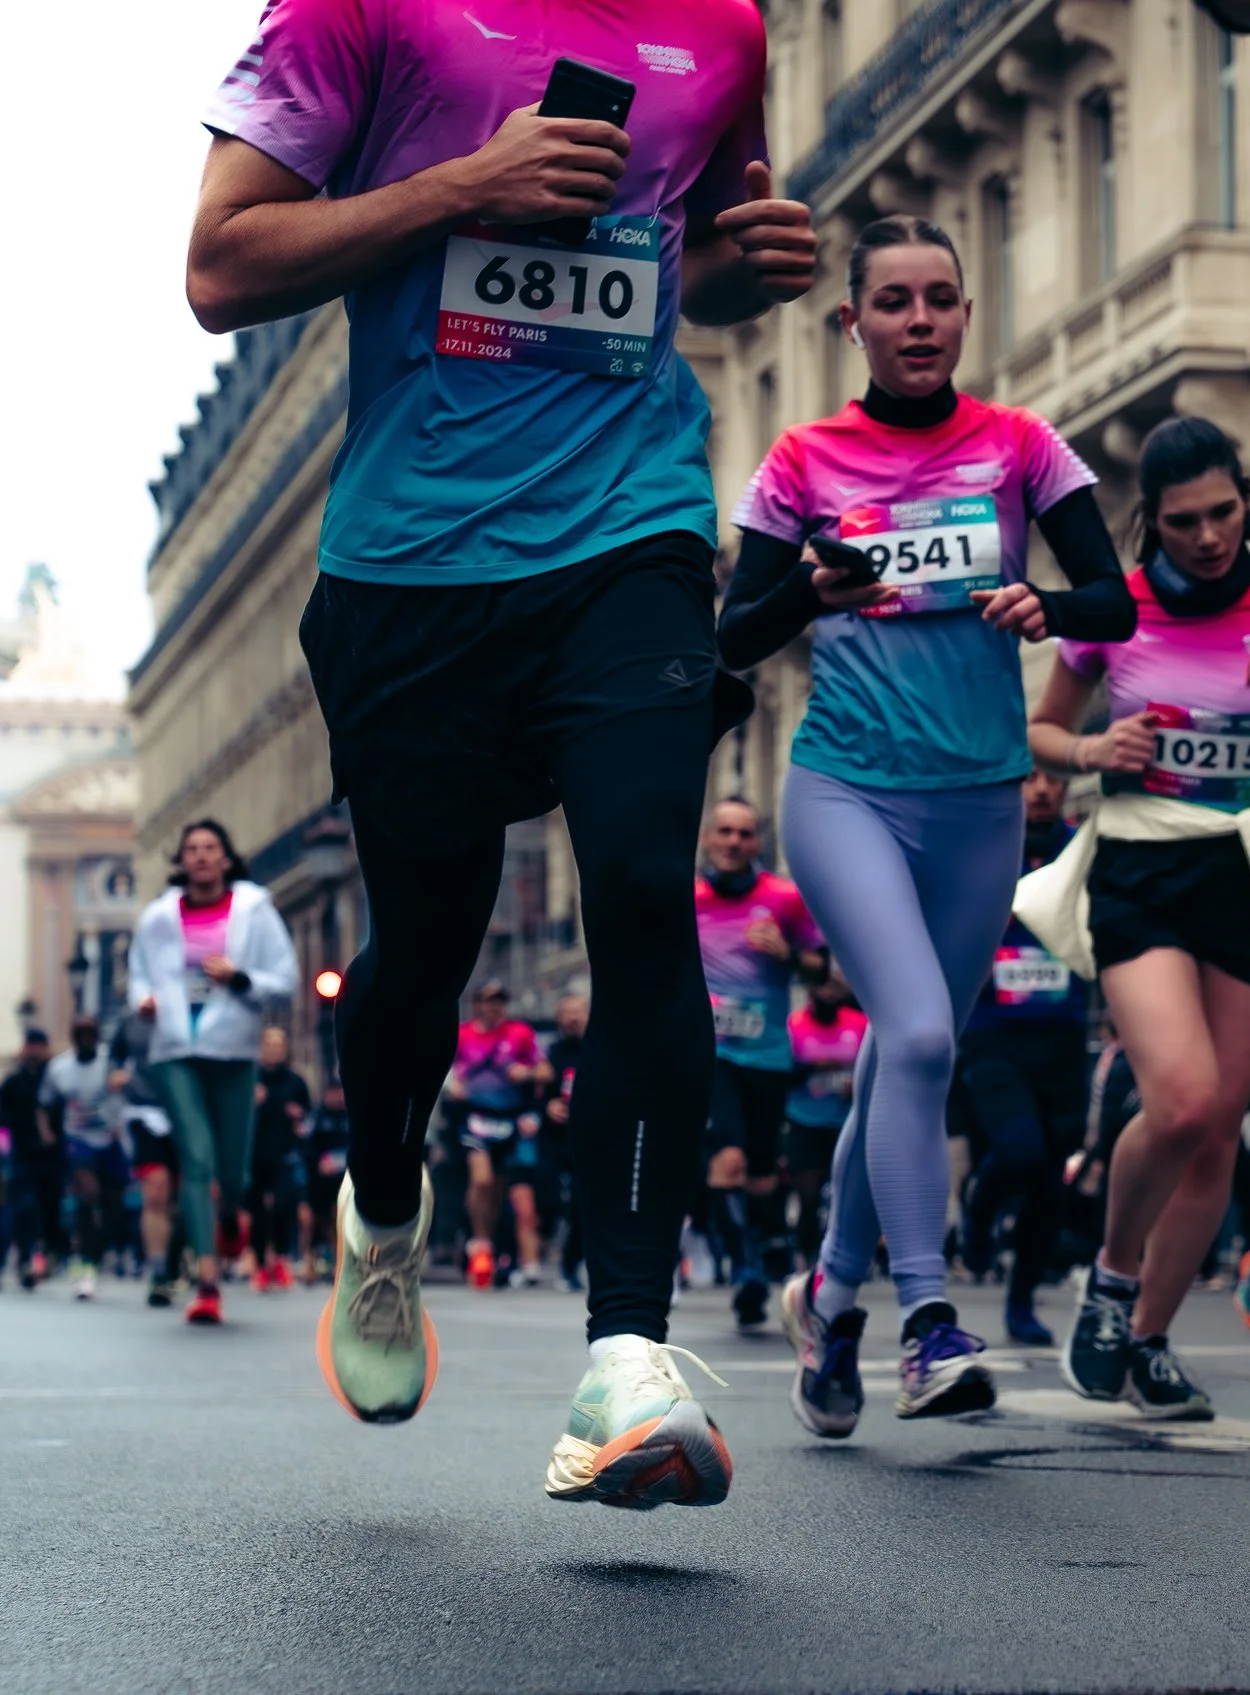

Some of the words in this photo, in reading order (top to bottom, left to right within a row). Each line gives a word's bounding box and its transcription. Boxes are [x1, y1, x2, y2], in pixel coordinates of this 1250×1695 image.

[609, 227, 651, 247] HOKA
[474, 255, 633, 319] 6810
[447, 318, 480, 332] LET'S
[484, 323, 506, 336] FLY
[508, 327, 547, 342] PARIS
[444, 339, 512, 359] 17.11.2024
[602, 338, 621, 350] -50
[623, 340, 647, 353] MIN
[951, 503, 987, 517] HOKA
[865, 535, 972, 579] 9541
